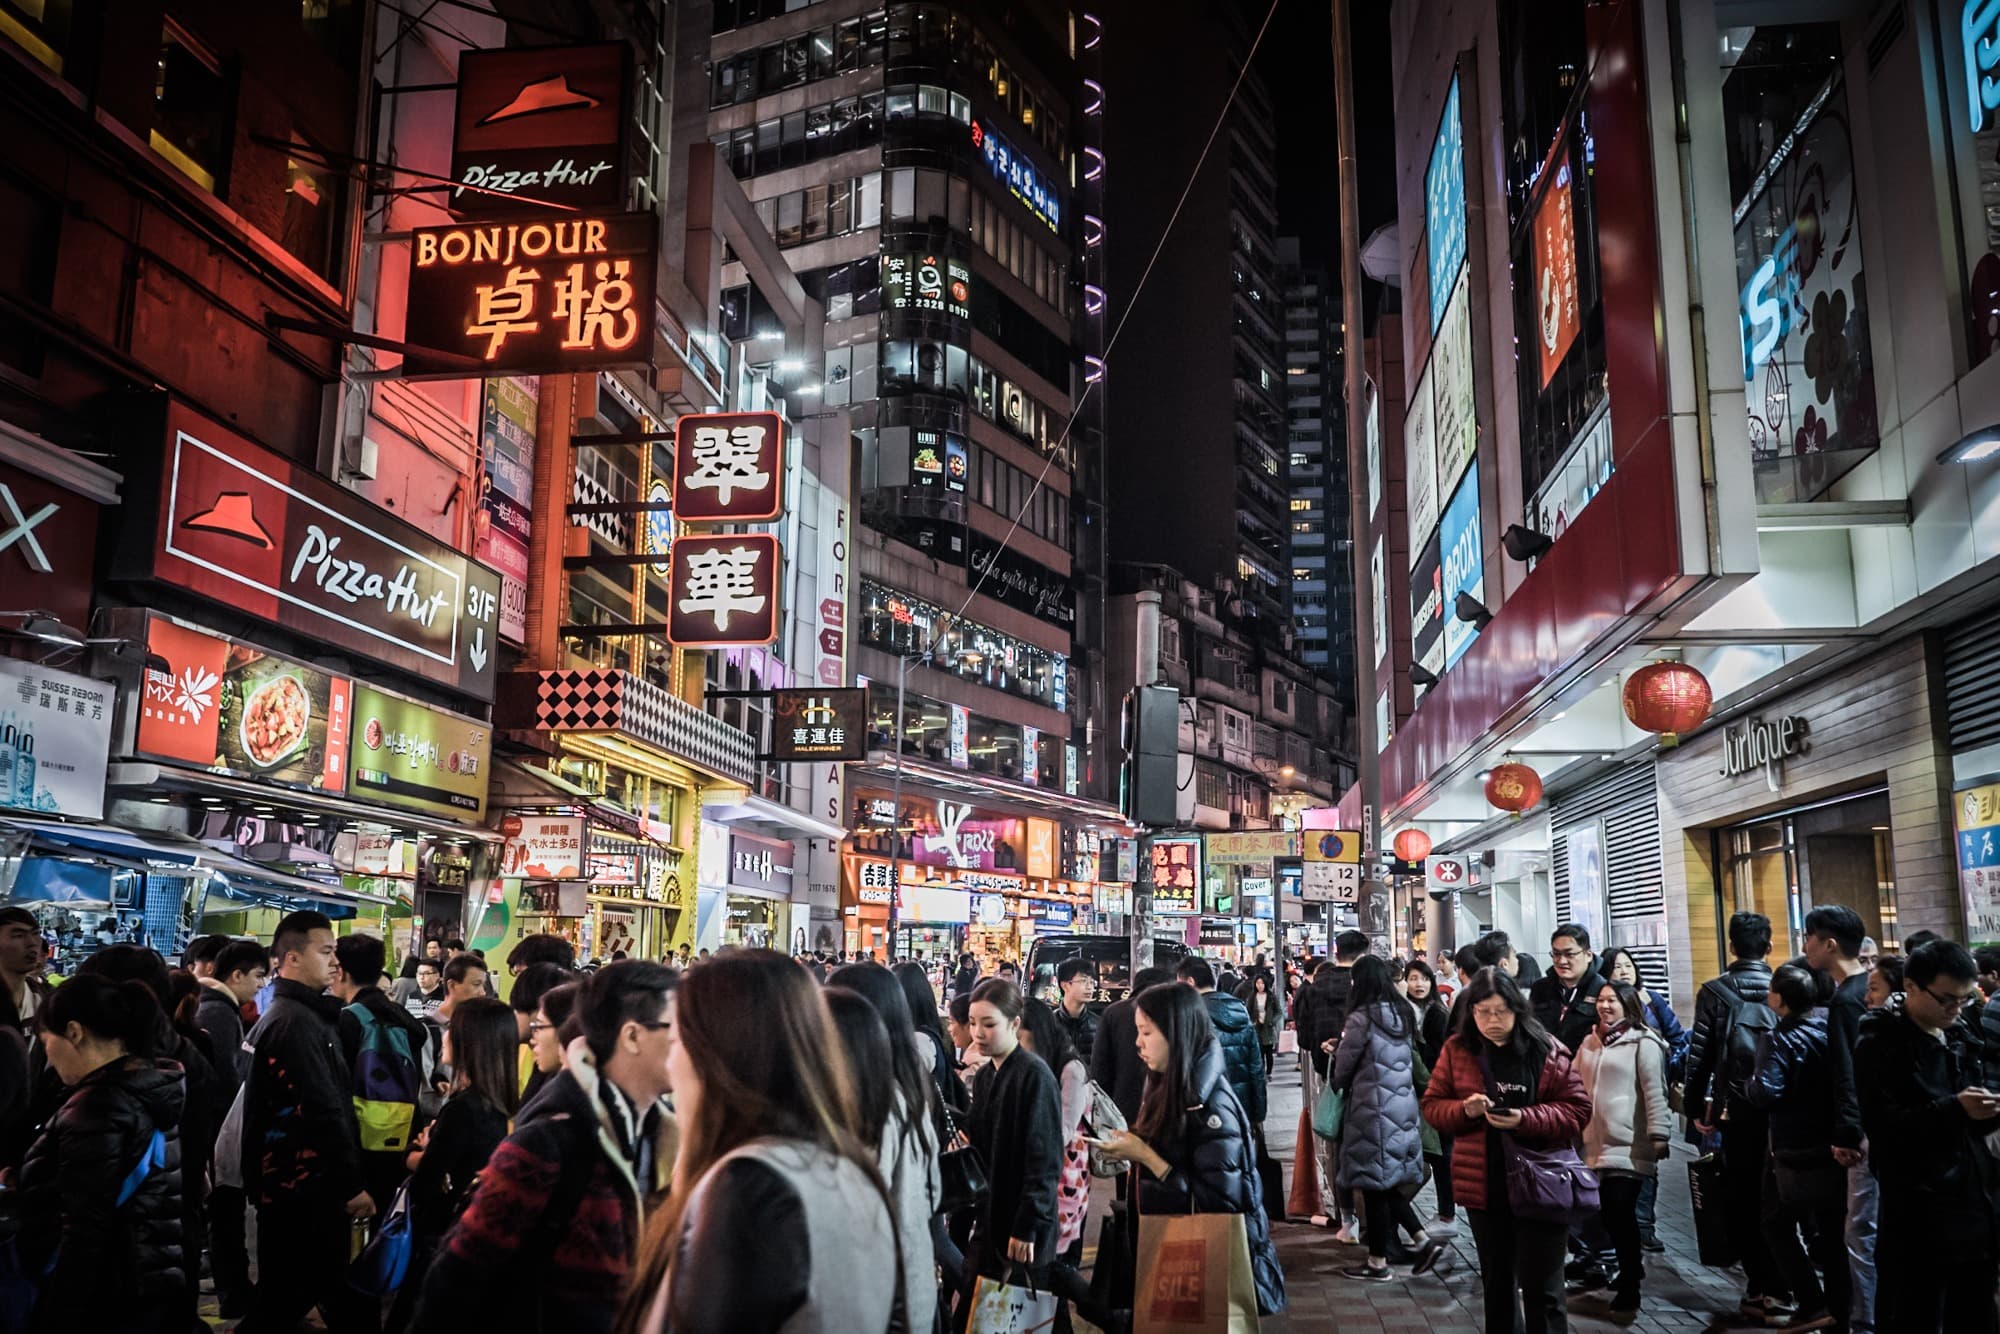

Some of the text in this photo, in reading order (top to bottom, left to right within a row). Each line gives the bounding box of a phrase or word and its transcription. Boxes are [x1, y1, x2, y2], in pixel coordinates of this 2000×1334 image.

[455, 159, 613, 197] Pizza Hut
[417, 220, 608, 266] BONJOUR
[1452, 505, 1482, 593] ROXY
[290, 524, 450, 628] Pizza Hut
[468, 584, 496, 623] 3/F
[146, 683, 174, 705] MX
[792, 728, 845, 744] 喜運佳
[1720, 716, 1794, 792] Jurlique
[529, 838, 579, 849] 汽水士多店
[1338, 867, 1353, 880] 12
[1338, 886, 1353, 898] 12
